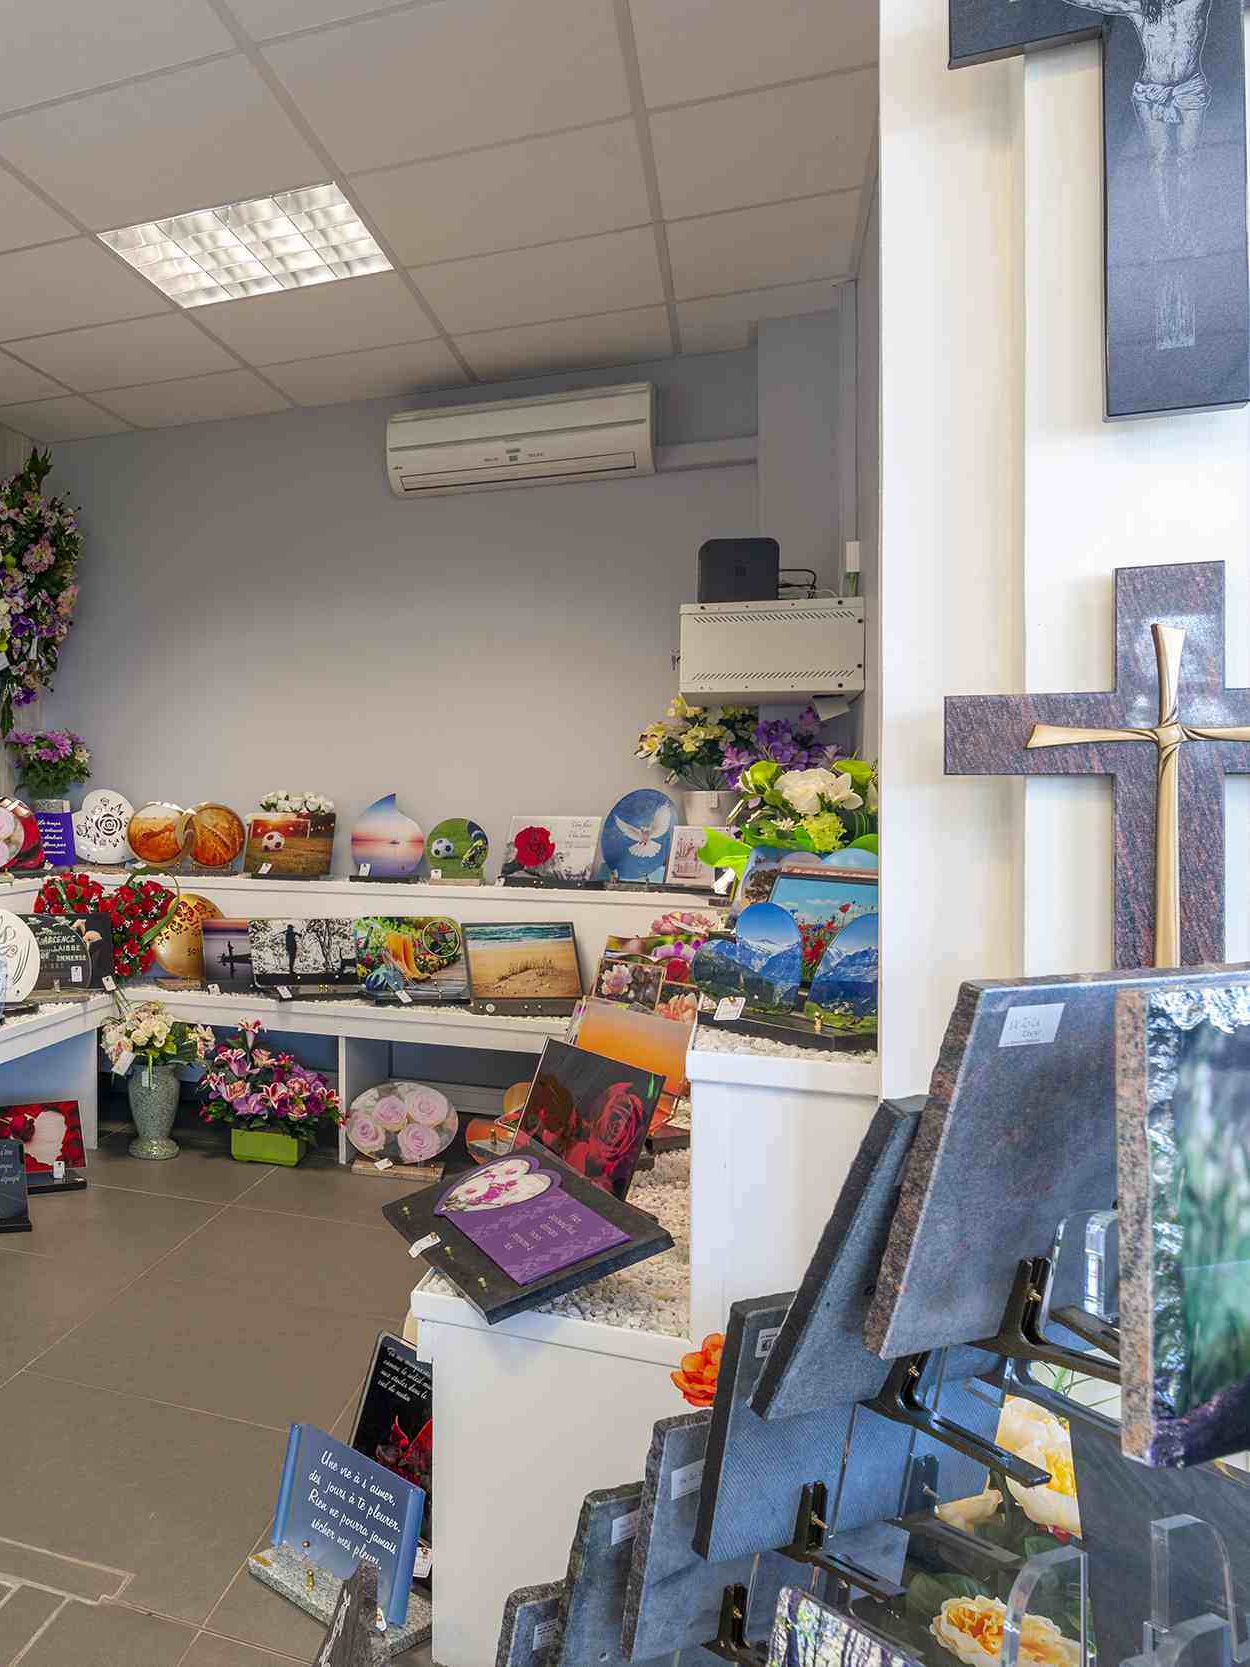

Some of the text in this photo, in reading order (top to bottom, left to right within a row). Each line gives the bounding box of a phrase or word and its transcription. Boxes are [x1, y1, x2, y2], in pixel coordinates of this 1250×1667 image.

[320, 1450, 338, 1472] Une
[340, 1466, 352, 1480] vie
[353, 1470, 361, 1485] à
[308, 1469, 401, 1533] des jours à te pleurer.
[308, 1488, 399, 1555] Rien ne pourra jamais
[310, 1518, 336, 1541] sécher
[336, 1535, 351, 1551] mes
